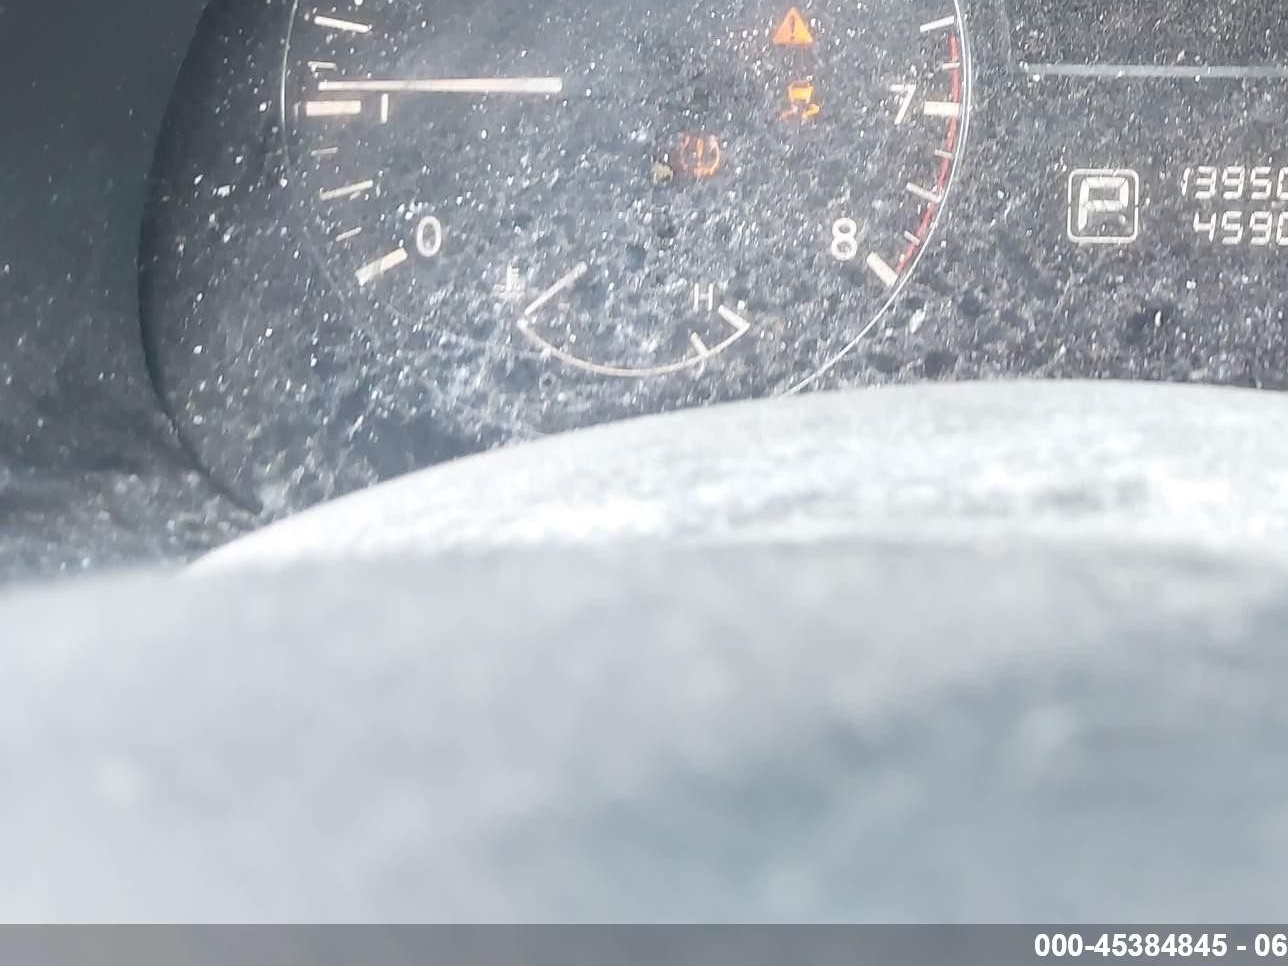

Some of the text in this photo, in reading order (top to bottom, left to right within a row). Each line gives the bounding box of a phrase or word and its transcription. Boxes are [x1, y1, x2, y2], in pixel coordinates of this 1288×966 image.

[890, 84, 916, 123] 7
[1079, 176, 1129, 232] P
[416, 216, 442, 255] 0
[830, 217, 858, 259] 8
[693, 282, 714, 312] H
